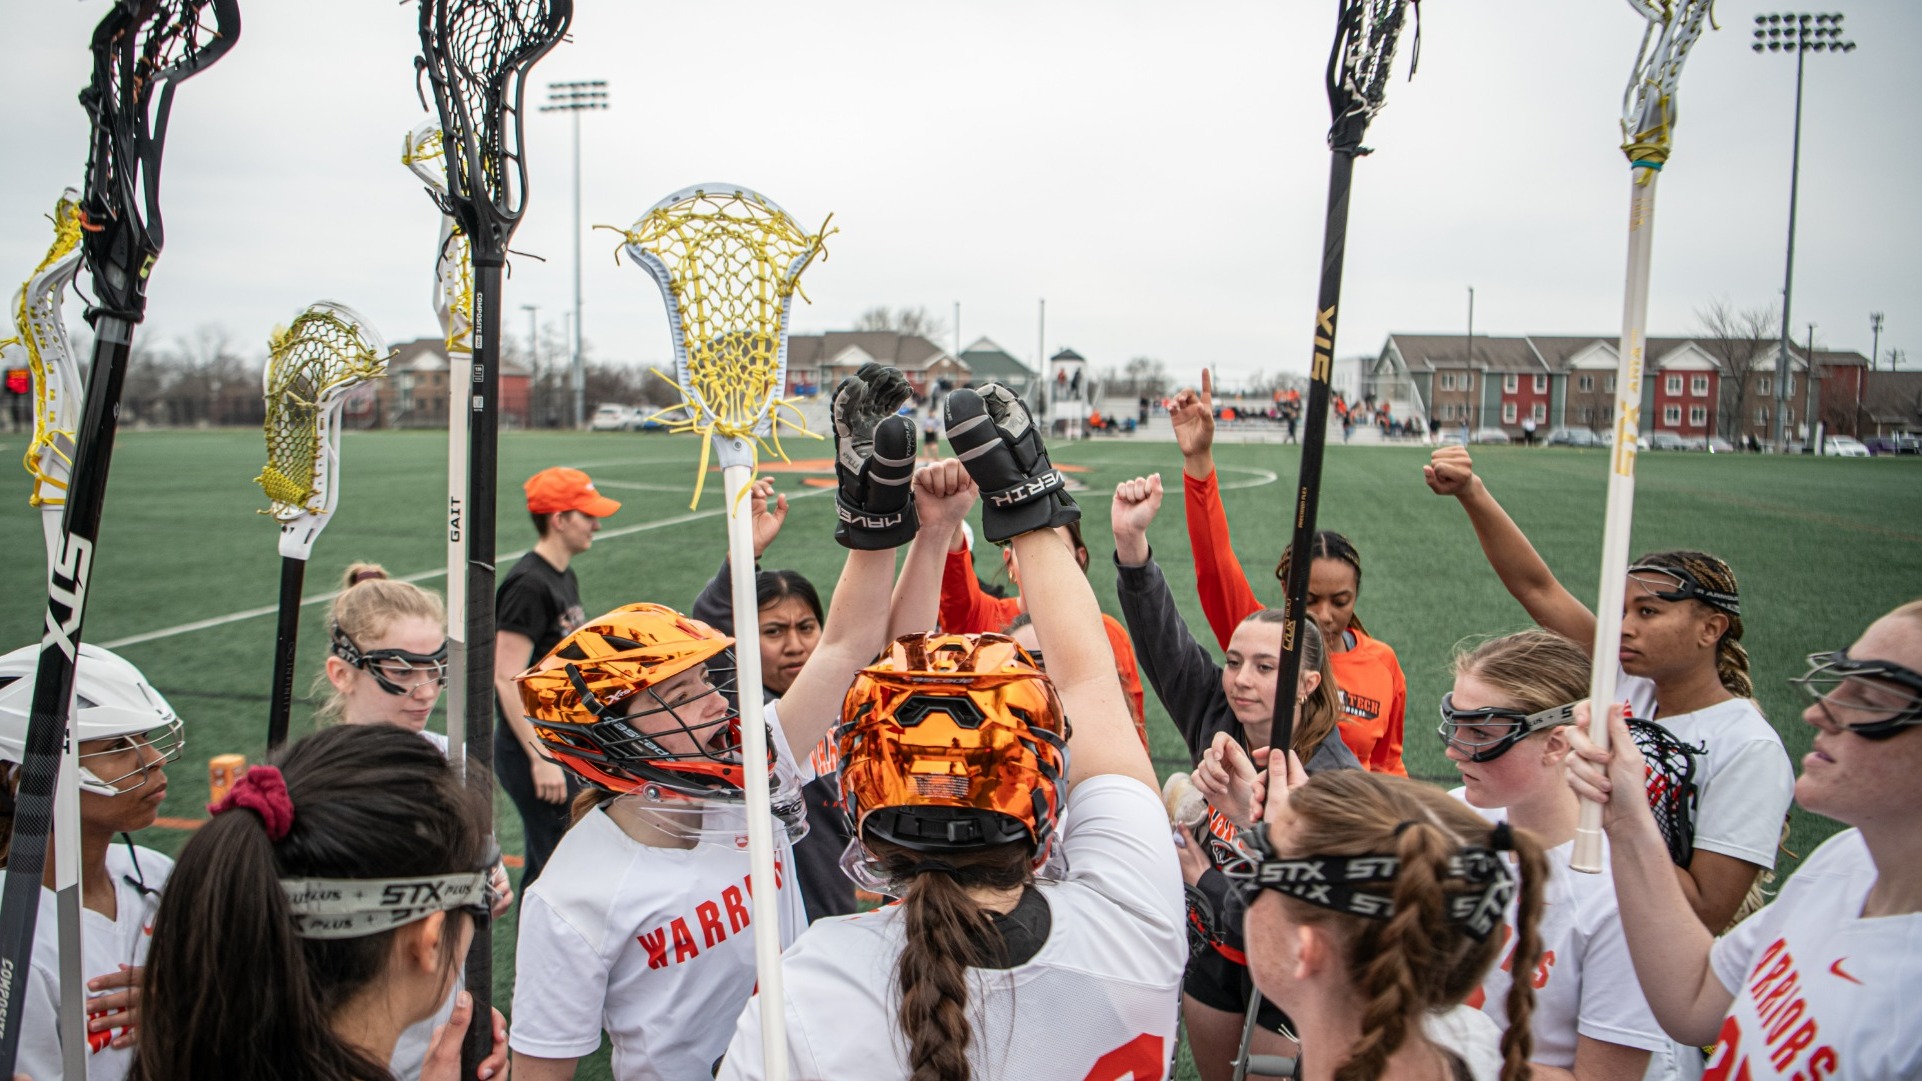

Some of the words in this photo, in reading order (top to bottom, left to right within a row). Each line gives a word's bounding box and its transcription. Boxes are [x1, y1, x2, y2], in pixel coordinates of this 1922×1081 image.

[451, 496, 461, 542] GAIT
[41, 531, 92, 664] STX
[1348, 694, 1380, 716] TECH
[1260, 860, 1327, 883] STX
[1346, 857, 1401, 880] ST
[379, 880, 445, 906] STX
[445, 885, 472, 896] PLUS
[1350, 893, 1396, 917] ST
